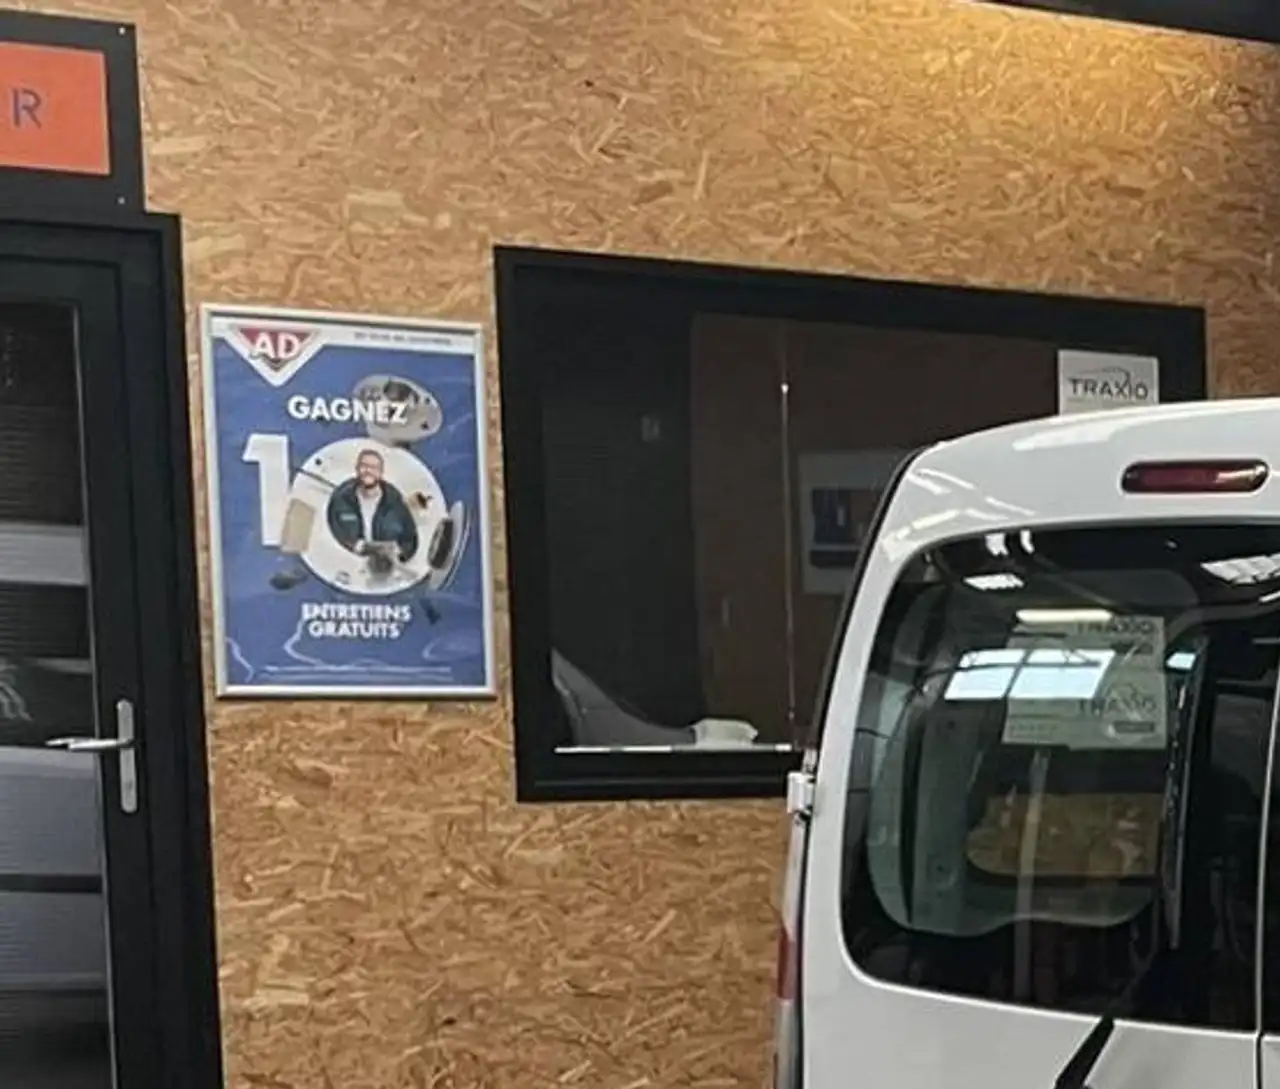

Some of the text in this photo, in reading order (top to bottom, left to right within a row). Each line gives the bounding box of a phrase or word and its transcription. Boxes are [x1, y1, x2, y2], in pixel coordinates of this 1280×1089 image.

[252, 331, 302, 359] AD
[1067, 377, 1149, 401] TRAXIO
[286, 396, 409, 424] GAGNEZ
[301, 602, 412, 623] ENTRETIENS
[308, 620, 400, 640] GRATUITS
